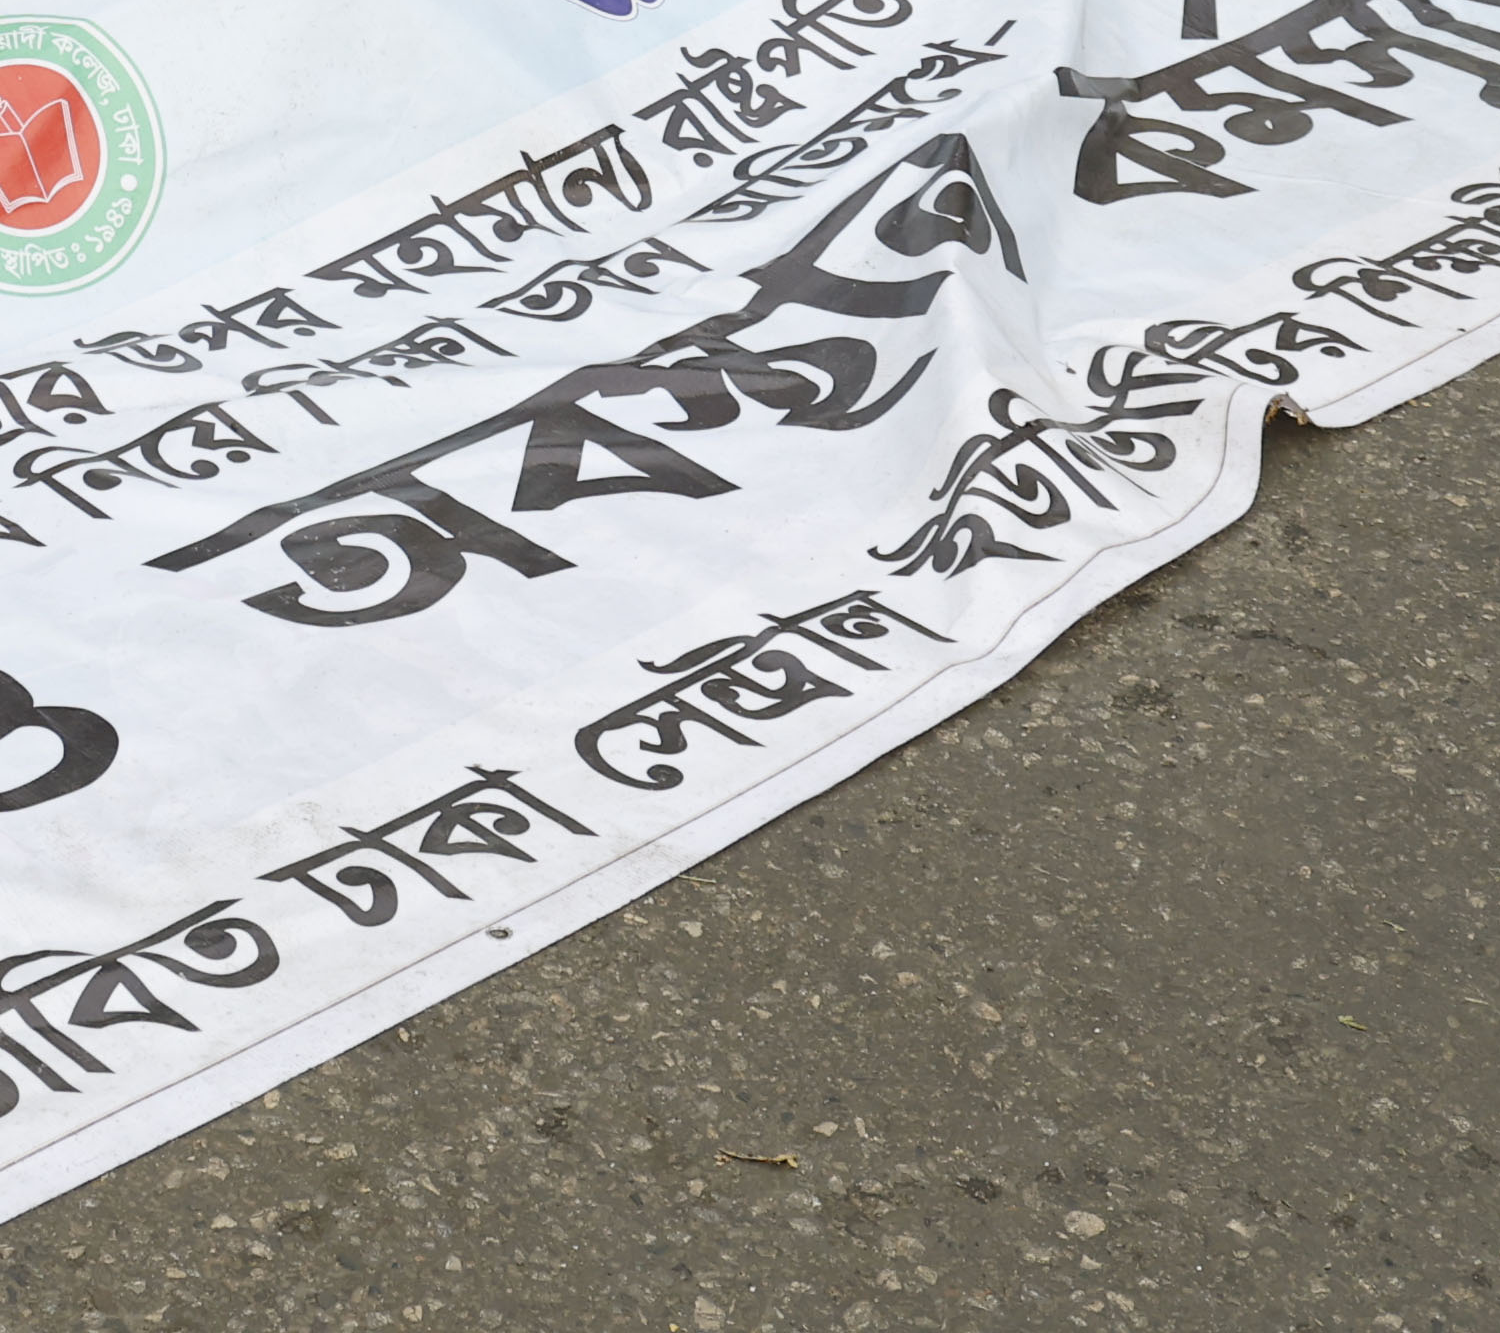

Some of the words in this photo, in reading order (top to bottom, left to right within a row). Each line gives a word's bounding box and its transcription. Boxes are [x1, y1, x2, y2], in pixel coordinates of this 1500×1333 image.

[74, 286, 343, 380] উপর
[306, 122, 653, 300] মহামান্য
[112, 103, 145, 166] ঢাকা
[12, 397, 281, 520] নিয়ে
[242, 313, 519, 426] শিক্ষা
[481, 235, 713, 322] ভবন
[260, 763, 597, 901] ঢাকা
[575, 589, 956, 791] সেন্ট্রাল
